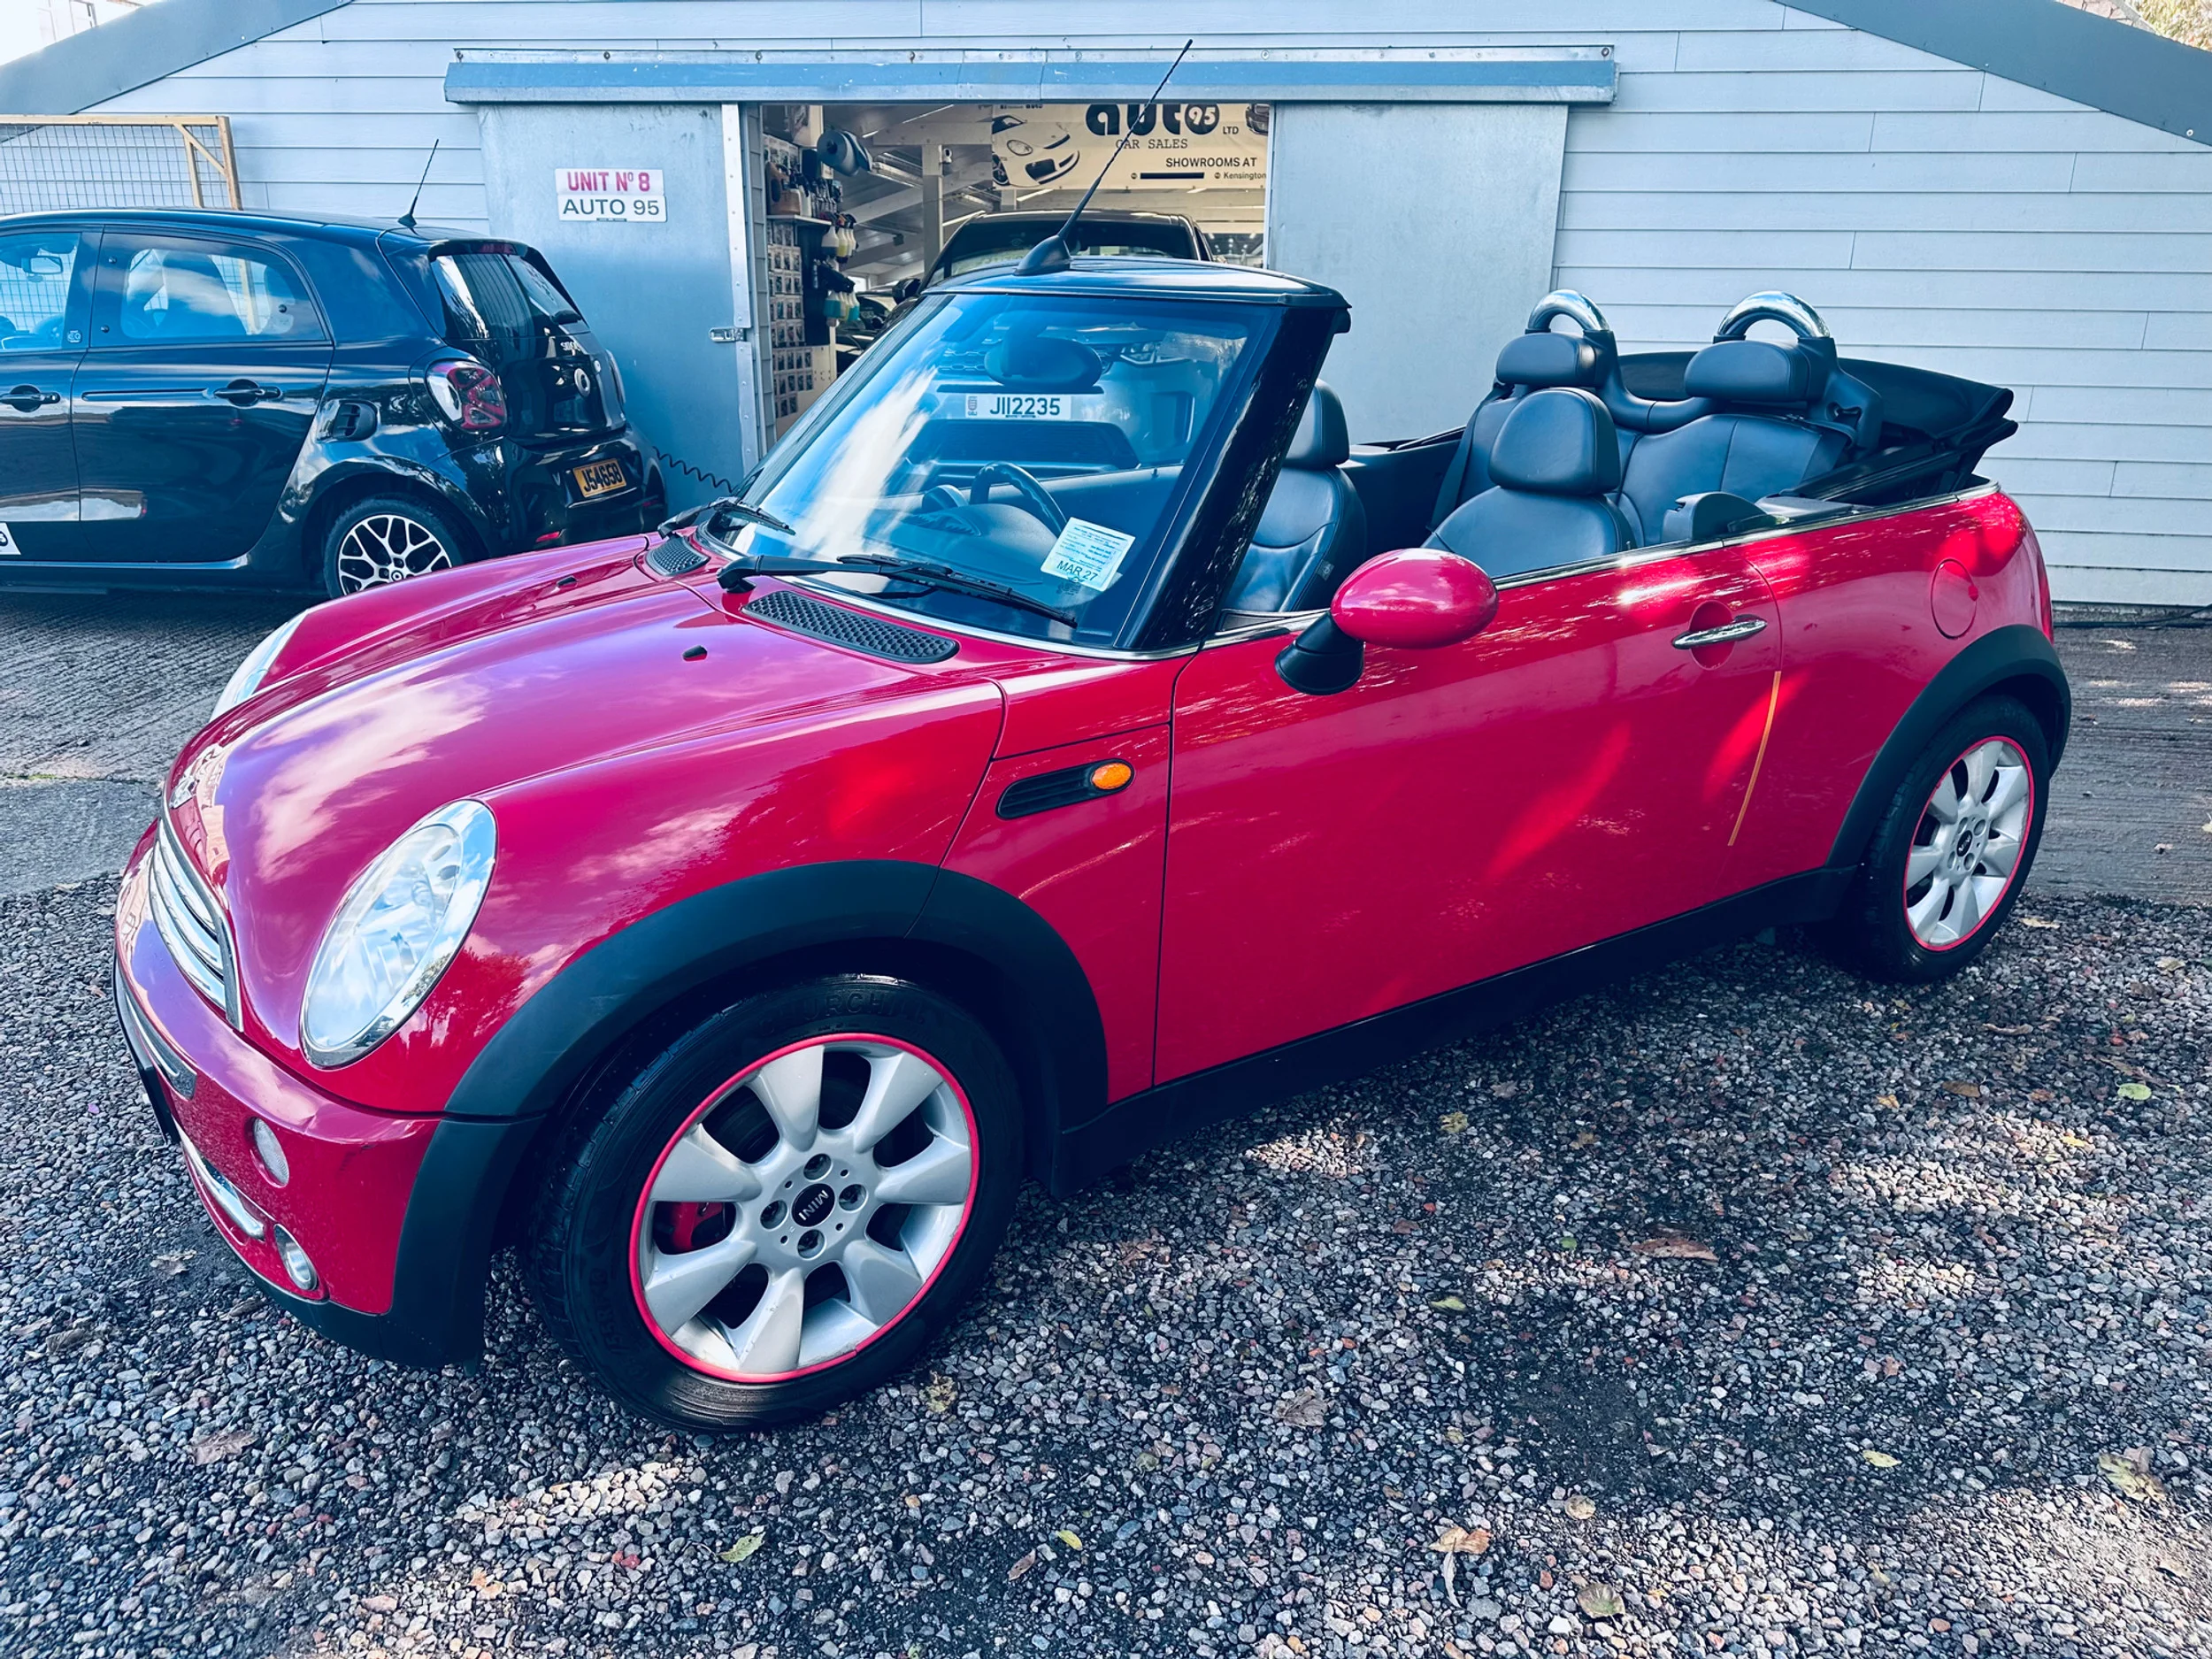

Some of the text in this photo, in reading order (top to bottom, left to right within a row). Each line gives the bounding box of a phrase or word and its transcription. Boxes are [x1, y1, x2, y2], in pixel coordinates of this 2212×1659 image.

[1116, 139, 1188, 149] CAR SALES
[1166, 157, 1257, 167] SHOWROOMS AT
[567, 172, 609, 191] UNIT
[638, 173, 650, 191] 8
[563, 199, 659, 215] AUTO 95
[1056, 560, 1098, 581] MAR 27
[798, 1189, 829, 1221] MINI
